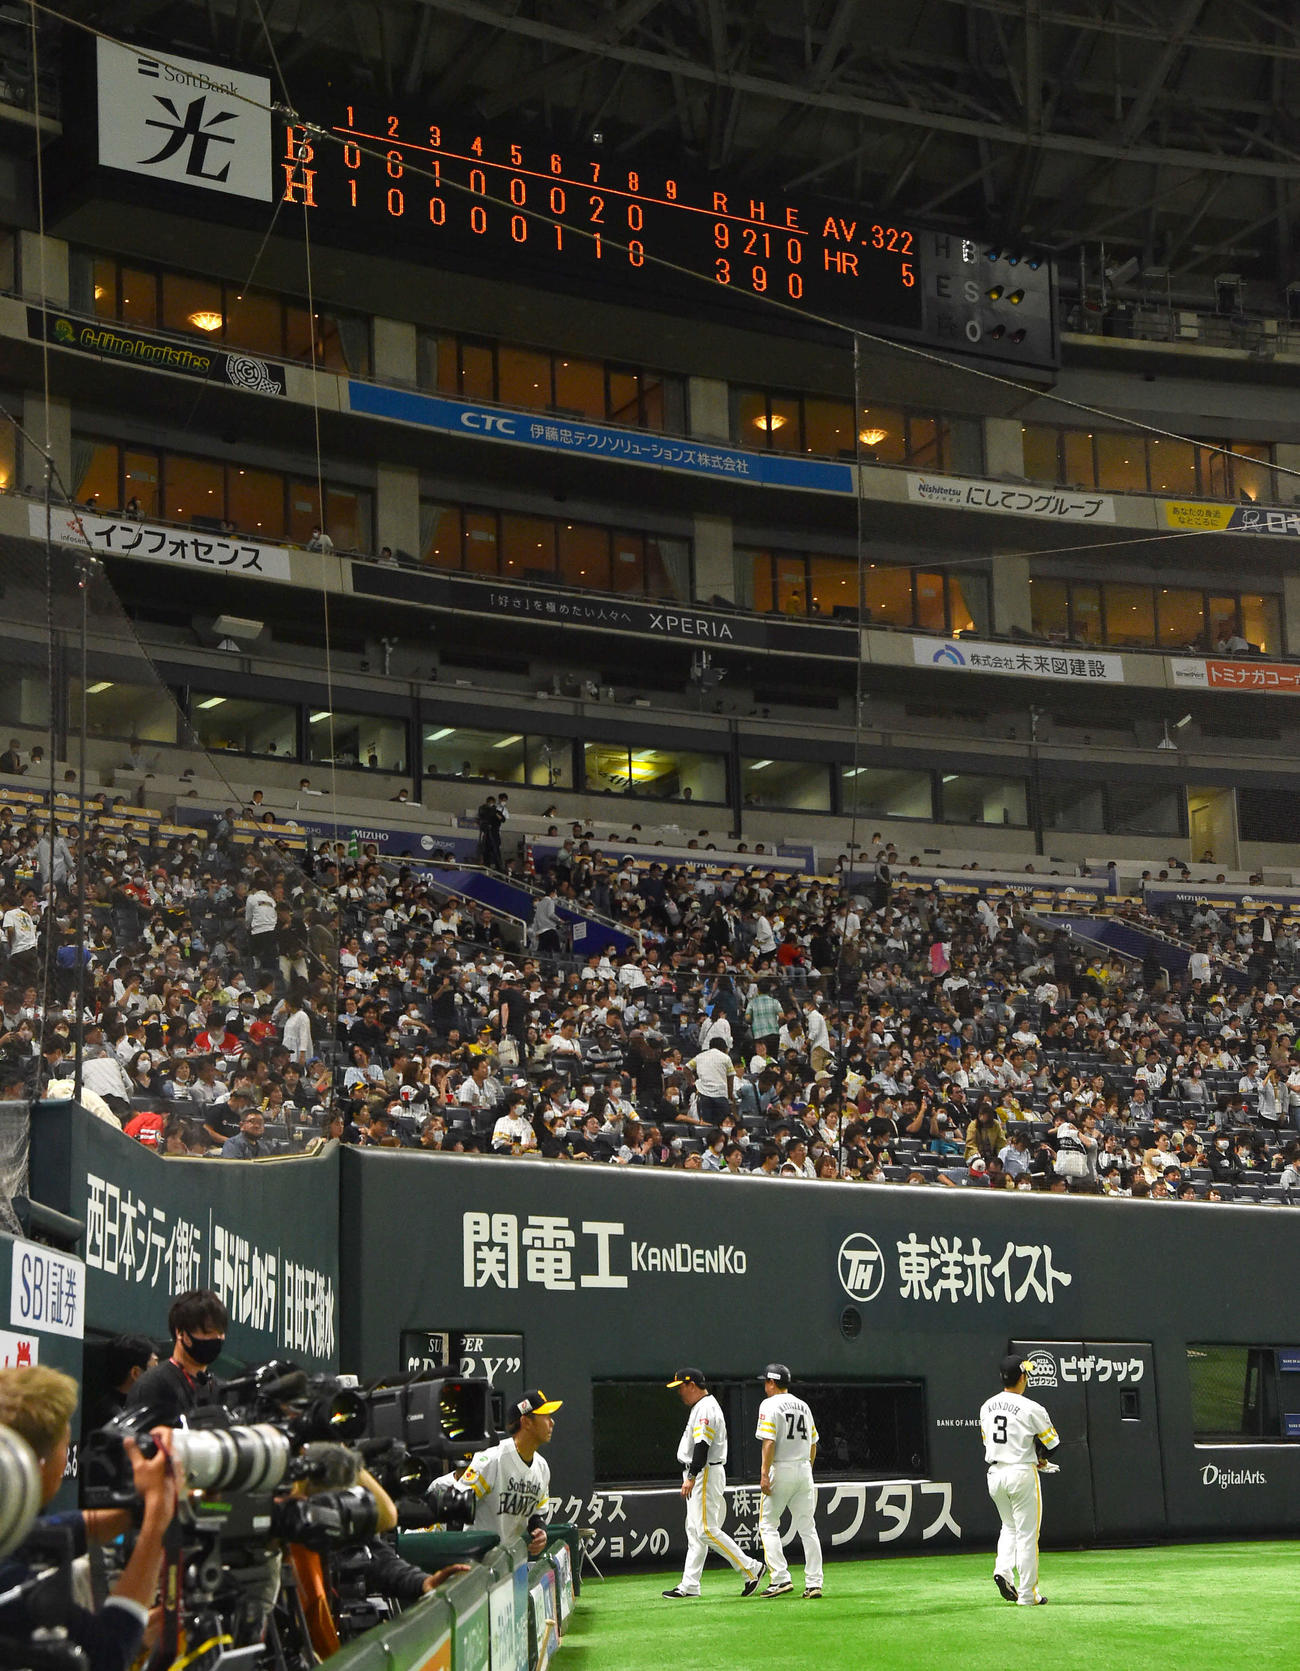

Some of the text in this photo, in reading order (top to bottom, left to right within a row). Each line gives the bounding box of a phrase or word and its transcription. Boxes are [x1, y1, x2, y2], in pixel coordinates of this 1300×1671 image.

[164, 63, 239, 96] SoftBank
[136, 95, 240, 183] 光
[346, 105, 799, 228] 1 2 3 4 5 6 7 8 9 R H E
[343, 140, 361, 170] 0
[431, 160, 440, 188] 1
[469, 168, 486, 197] 0
[510, 178, 526, 206] 0
[550, 186, 566, 215] 0
[589, 195, 605, 224] 2
[627, 203, 643, 231] 0
[714, 222, 729, 249] 9
[742, 228, 771, 258] 21
[787, 238, 802, 264] 0
[281, 163, 803, 299] H 1 0 0 0 0 1 1 0 3 9 0
[824, 248, 915, 287] HR 5
[964, 280, 980, 303] S
[134, 340, 210, 373] Logistics
[460, 411, 518, 435] CTC
[918, 483, 962, 496] Nishitetsu
[965, 486, 1104, 518] にしてつグループ
[94, 524, 263, 572] インフォセンス
[649, 613, 733, 640] XPERIA
[86, 1172, 201, 1296] 西日本シティ銀行
[462, 1210, 629, 1291] 関電工
[895, 1232, 1072, 1304] 東洋ホイスト
[20, 1252, 77, 1328] SBI証券
[1059, 1355, 1145, 1382] ピザクック
[785, 1413, 808, 1440] 74
[936, 1419, 954, 1427] BANK
[955, 1419, 964, 1427] OF
[992, 1415, 1008, 1444] 3
